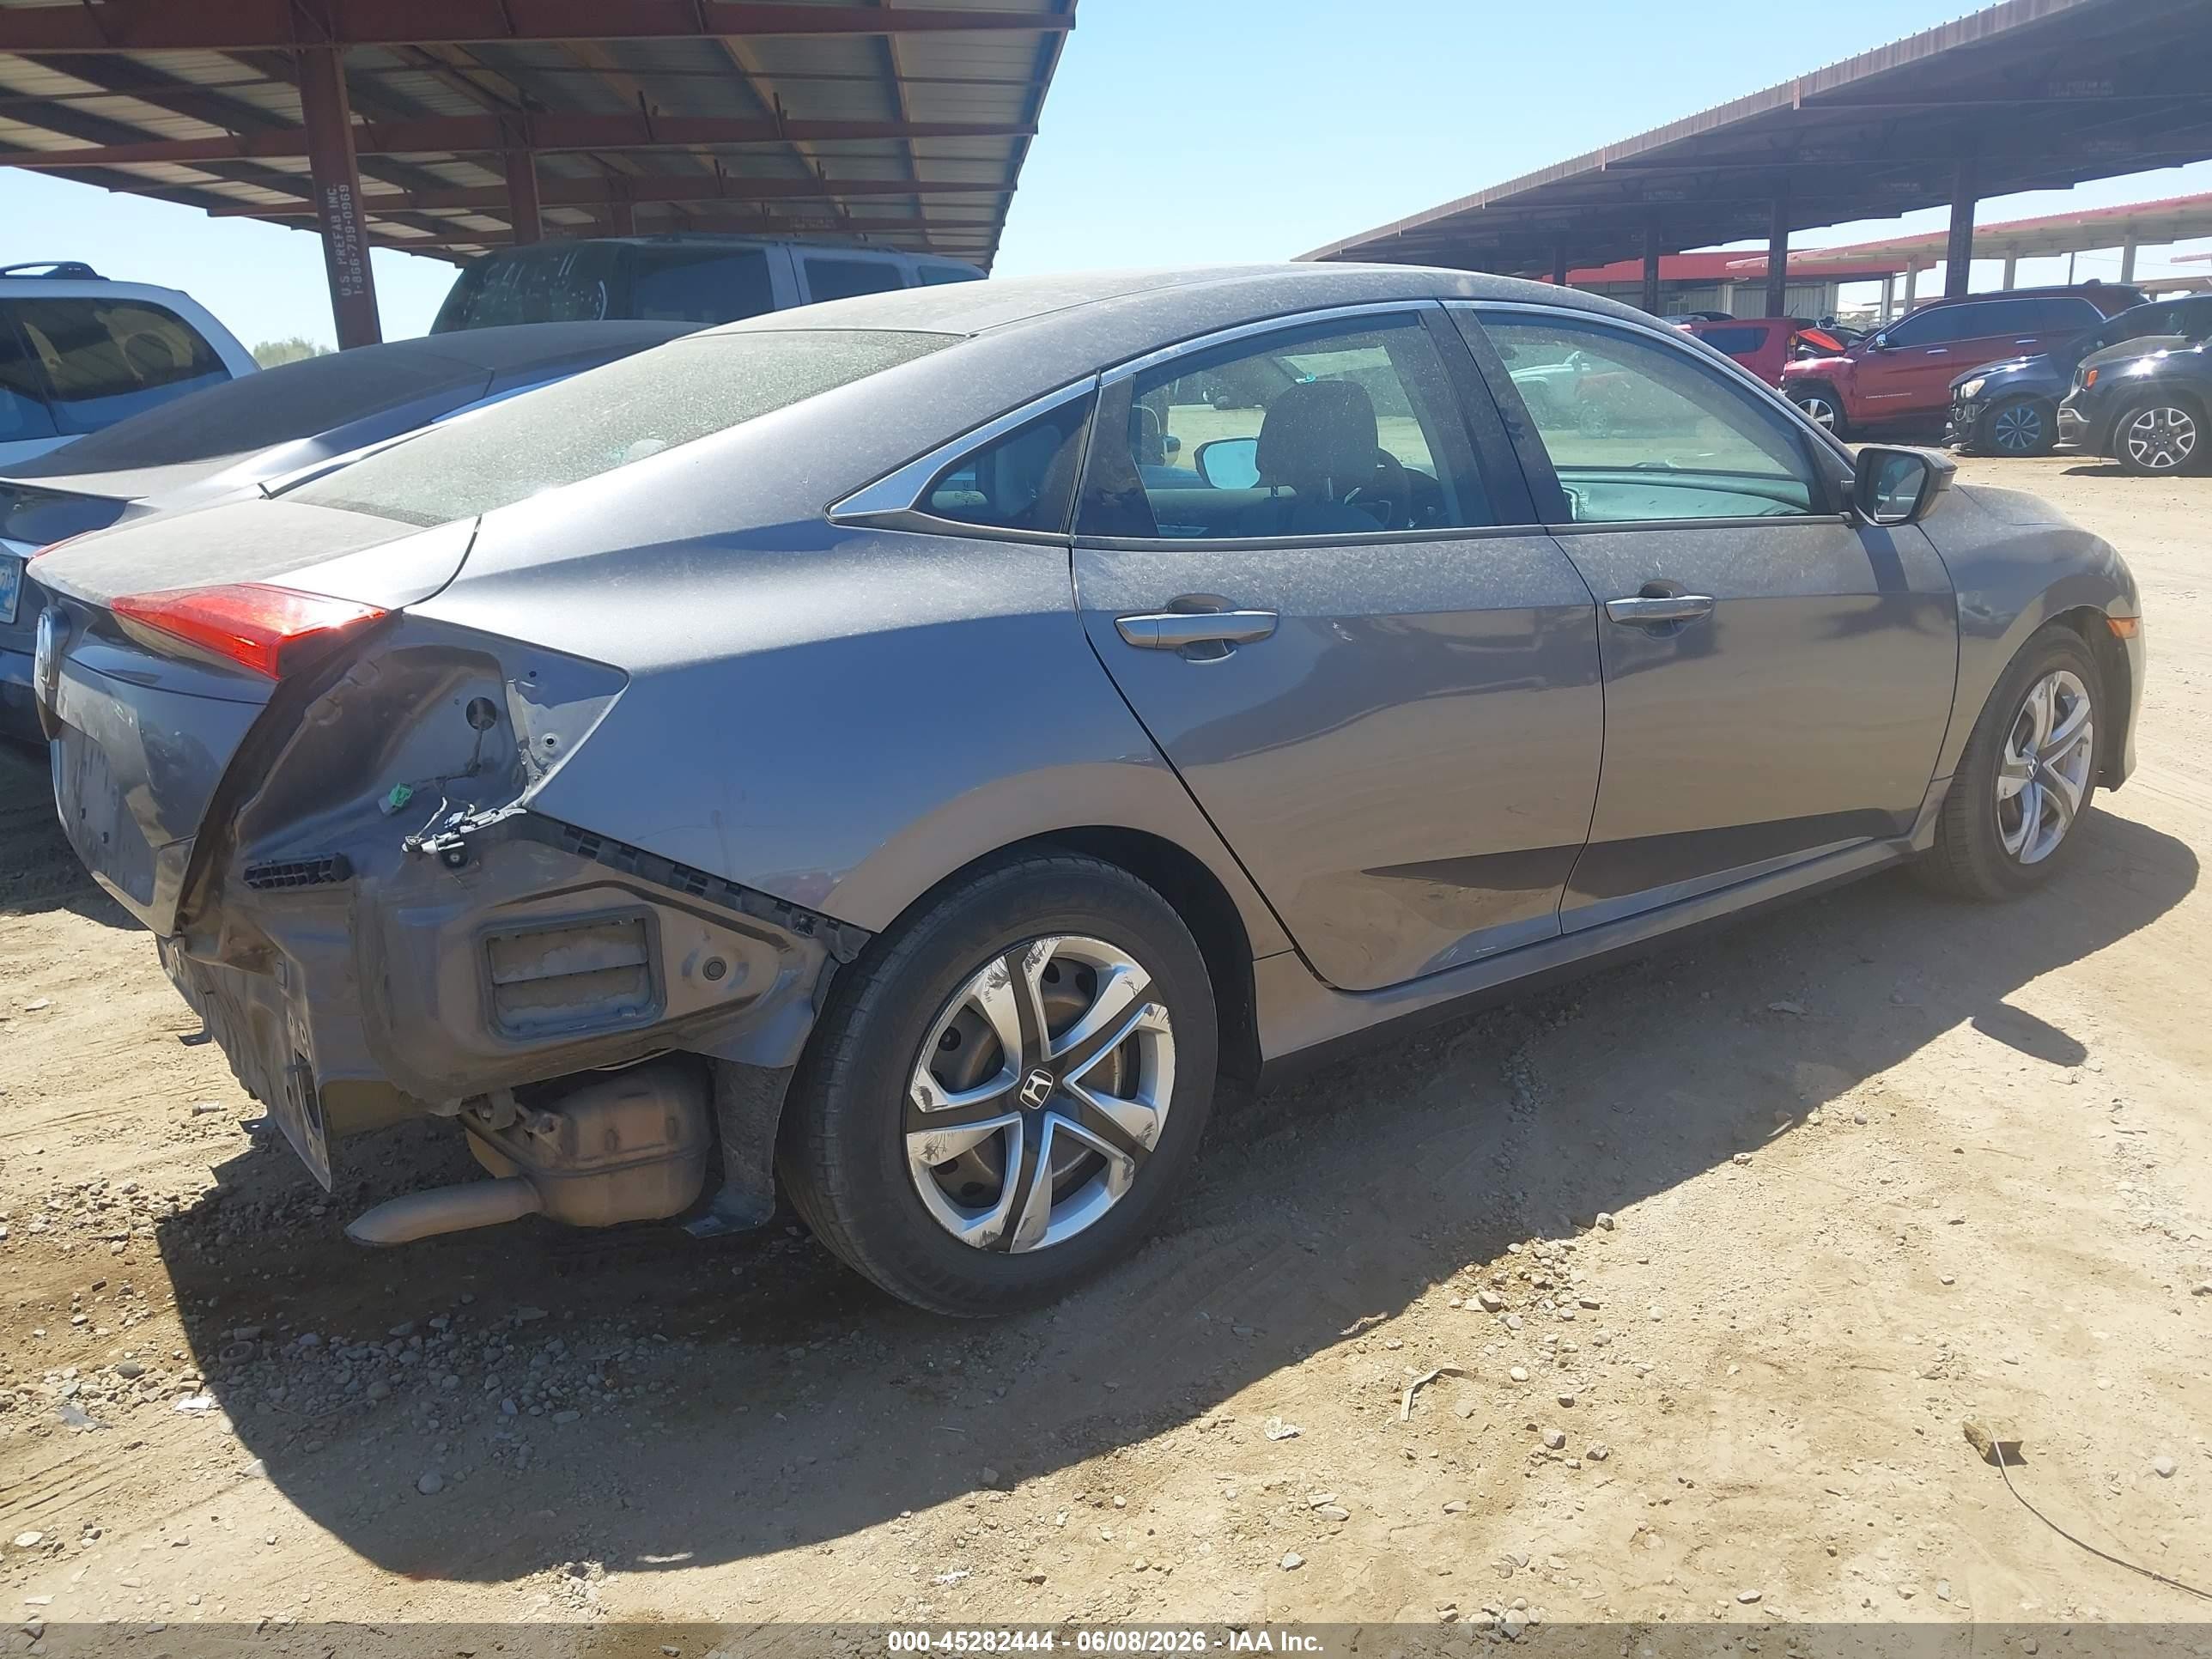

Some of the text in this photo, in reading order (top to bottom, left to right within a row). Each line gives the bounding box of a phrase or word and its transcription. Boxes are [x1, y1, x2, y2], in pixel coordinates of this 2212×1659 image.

[327, 184, 338, 208] INC.
[331, 215, 348, 264] PREFAB
[339, 185, 363, 295] 1-866-799-0969
